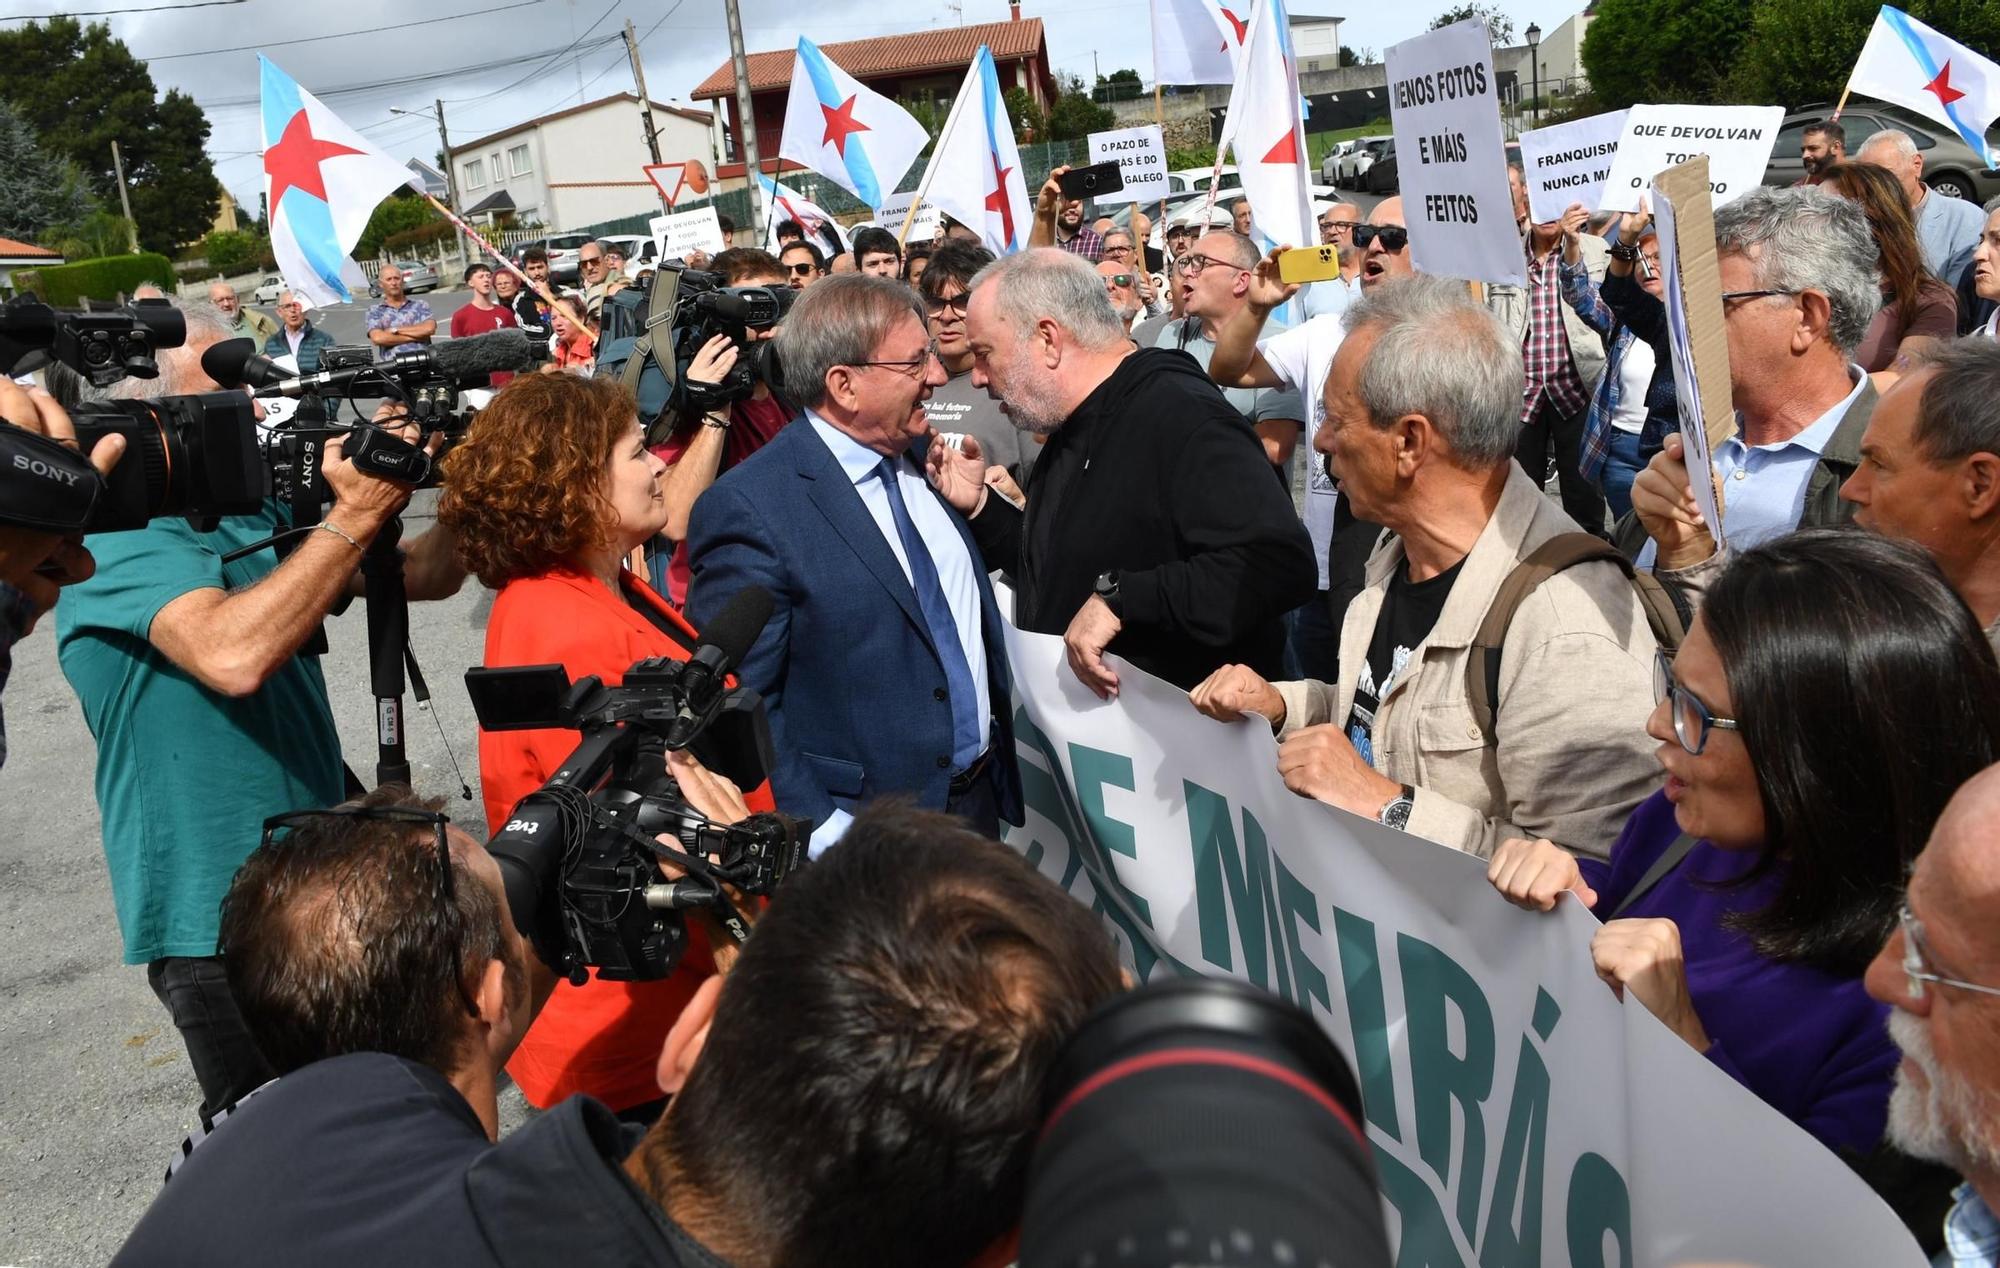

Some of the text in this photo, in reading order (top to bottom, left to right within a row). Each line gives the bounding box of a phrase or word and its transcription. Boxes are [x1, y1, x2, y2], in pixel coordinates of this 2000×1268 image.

[1394, 62, 1487, 109] MENOS FOTOS
[1633, 125, 1762, 141] QUE DEVOLVAN
[1101, 138, 1150, 152] O PAZO DE
[1419, 127, 1467, 164] E MÁIS
[1135, 154, 1142, 166] É
[1144, 154, 1157, 165] DO
[1537, 141, 1618, 168] FRANQUISM
[1666, 152, 1710, 164] TO
[1124, 172, 1163, 184] GALEGO
[1542, 173, 1590, 192] NUNCA
[1630, 176, 1642, 188] O
[1425, 194, 1478, 224] FEITOS
[13, 454, 79, 487] SONY
[303, 441, 315, 489] SONY
[505, 819, 539, 835] tve
